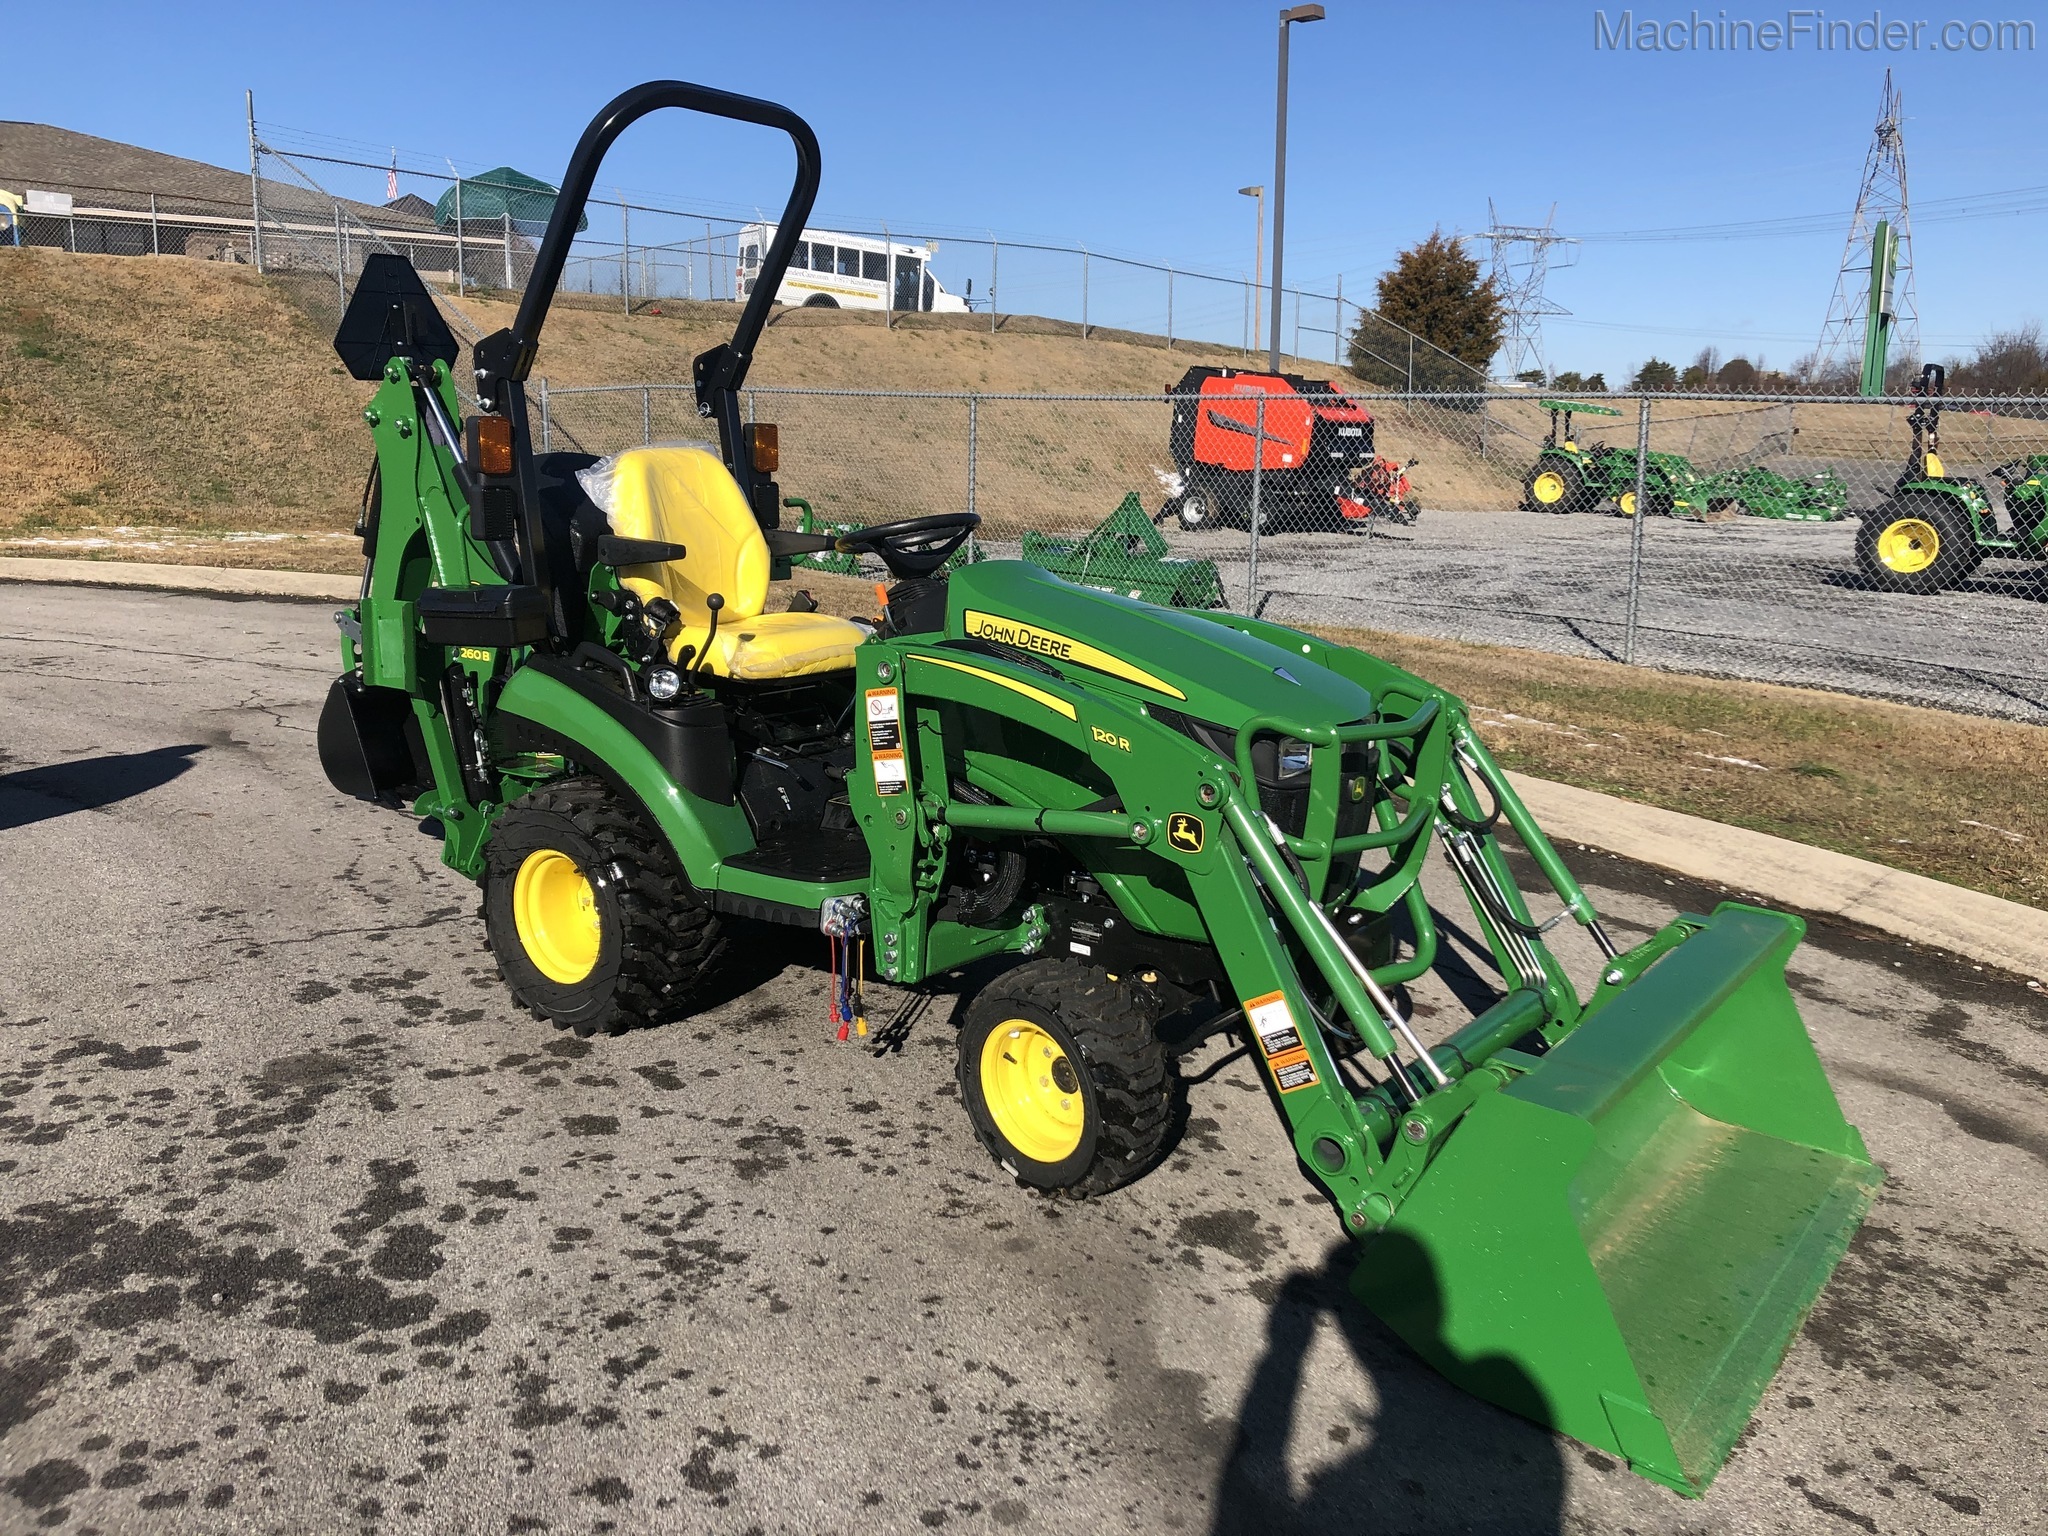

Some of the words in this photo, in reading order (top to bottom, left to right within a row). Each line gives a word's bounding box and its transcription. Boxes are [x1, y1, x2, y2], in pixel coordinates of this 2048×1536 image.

[1233, 383, 1266, 394] KUBOTA
[1338, 427, 1362, 437] KUBOTA
[974, 619, 1015, 644] JOHN
[1018, 629, 1072, 658] DEERE
[460, 647, 481, 660] 260
[482, 650, 490, 661] B
[871, 688, 896, 697] WARNING
[1091, 725, 1117, 747] 120
[1118, 736, 1132, 753] R
[877, 752, 902, 761] WARNING
[1256, 994, 1280, 1005] WARNING
[1280, 1054, 1305, 1065] WARNING
